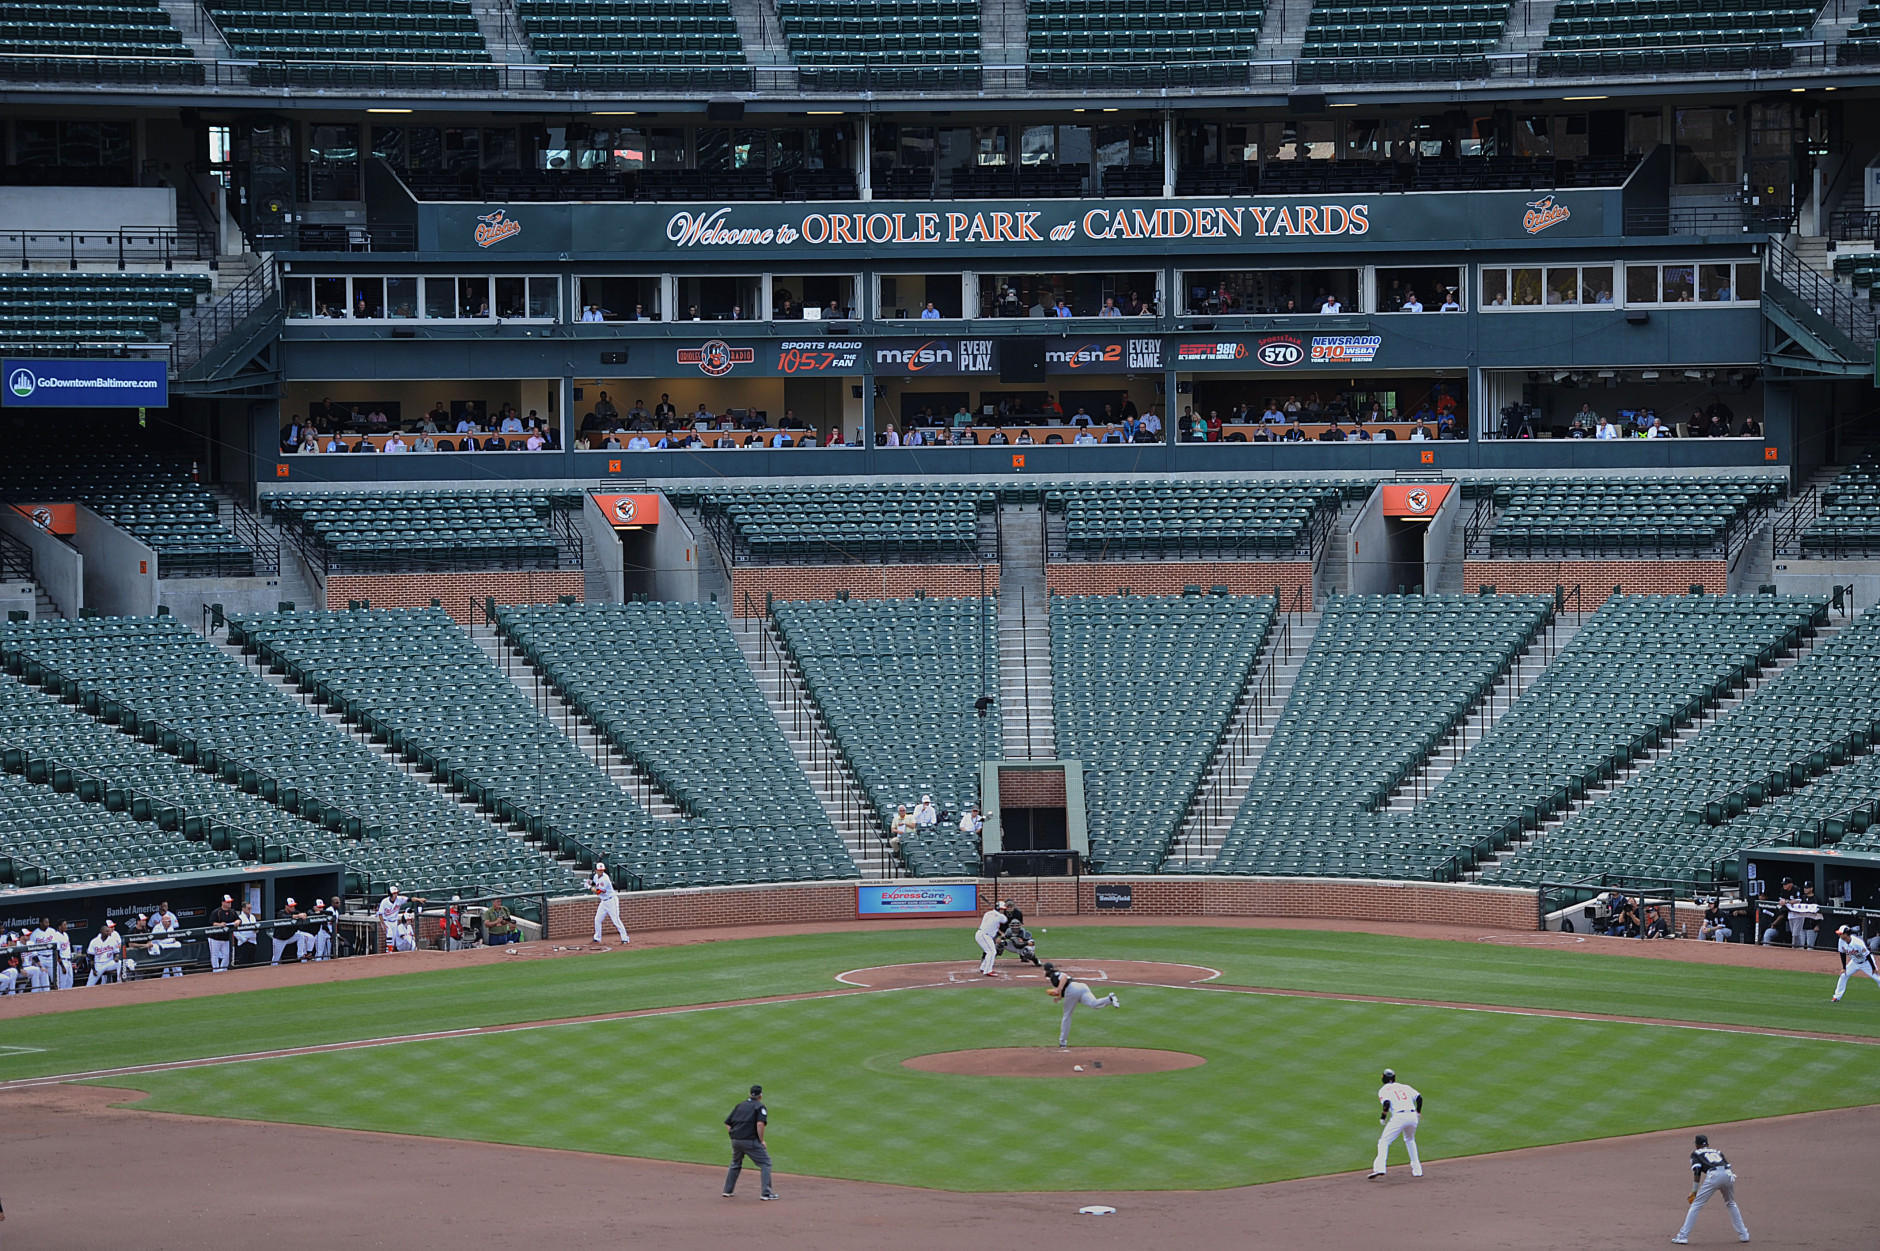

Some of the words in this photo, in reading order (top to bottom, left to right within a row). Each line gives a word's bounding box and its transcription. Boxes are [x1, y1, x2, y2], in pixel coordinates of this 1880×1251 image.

[666, 207, 773, 246] Welcome
[776, 223, 799, 244] to
[802, 213, 941, 244] ORIOLE
[945, 211, 1044, 242] PARK
[1049, 220, 1076, 241] at
[1083, 207, 1245, 239] CAMDEN
[1249, 205, 1370, 236] YARDS
[1523, 204, 1571, 234] Orioles
[474, 218, 522, 248] Orioles
[781, 341, 825, 350] SPORTS
[827, 341, 863, 350] RADIO
[961, 340, 993, 355] EVERY
[1129, 339, 1162, 354] EVERY
[1312, 336, 1382, 346] NEWSRADIO
[680, 351, 701, 361] ORIOLES
[730, 350, 751, 360] RADIO
[1179, 343, 1217, 355] ESPN
[1216, 343, 1237, 355] 980
[1264, 347, 1298, 362] 570
[1311, 345, 1345, 358] 910
[876, 349, 953, 363] masn
[961, 354, 993, 371] PLAY.
[1129, 353, 1163, 368] GAME.
[832, 359, 854, 367] FAN
[37, 377, 158, 388] GoDowntownBaltimore.com
[881, 891, 945, 900] ExpressCare
[107, 907, 123, 917] Bank
[125, 906, 132, 915] of
[132, 903, 160, 914] America
[11, 916, 40, 927] America
[1394, 1090, 1408, 1101] 13
